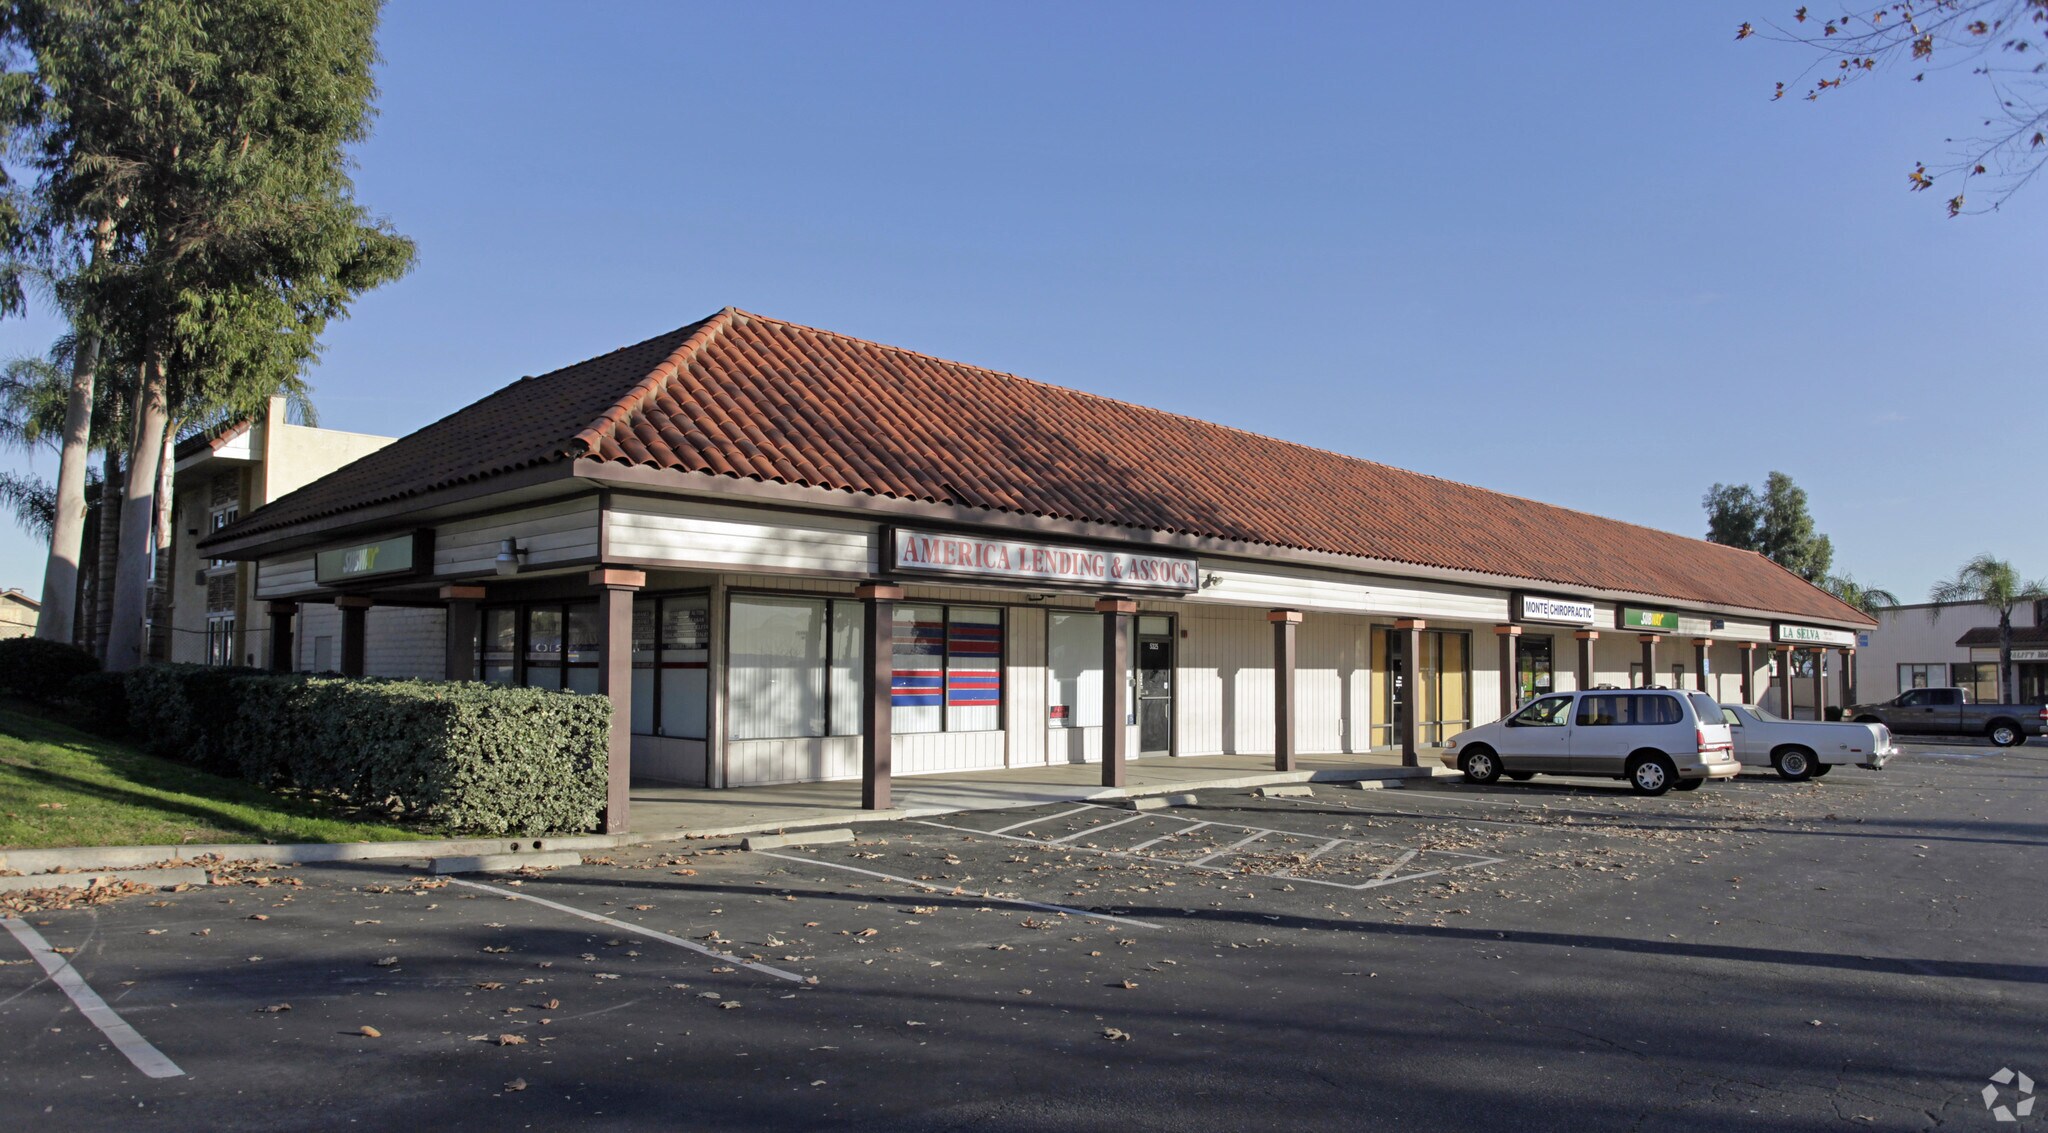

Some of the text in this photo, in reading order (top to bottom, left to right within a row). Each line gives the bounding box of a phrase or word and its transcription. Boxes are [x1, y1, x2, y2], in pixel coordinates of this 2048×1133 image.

[904, 536, 1194, 584] AMERICA LENDING & ASSOCS.
[1525, 601, 1592, 618] MONTE CHIROPRACTIC
[1641, 611, 1664, 626] SUBWAY
[1783, 627, 1794, 638] LA
[1796, 628, 1820, 640] SELVA
